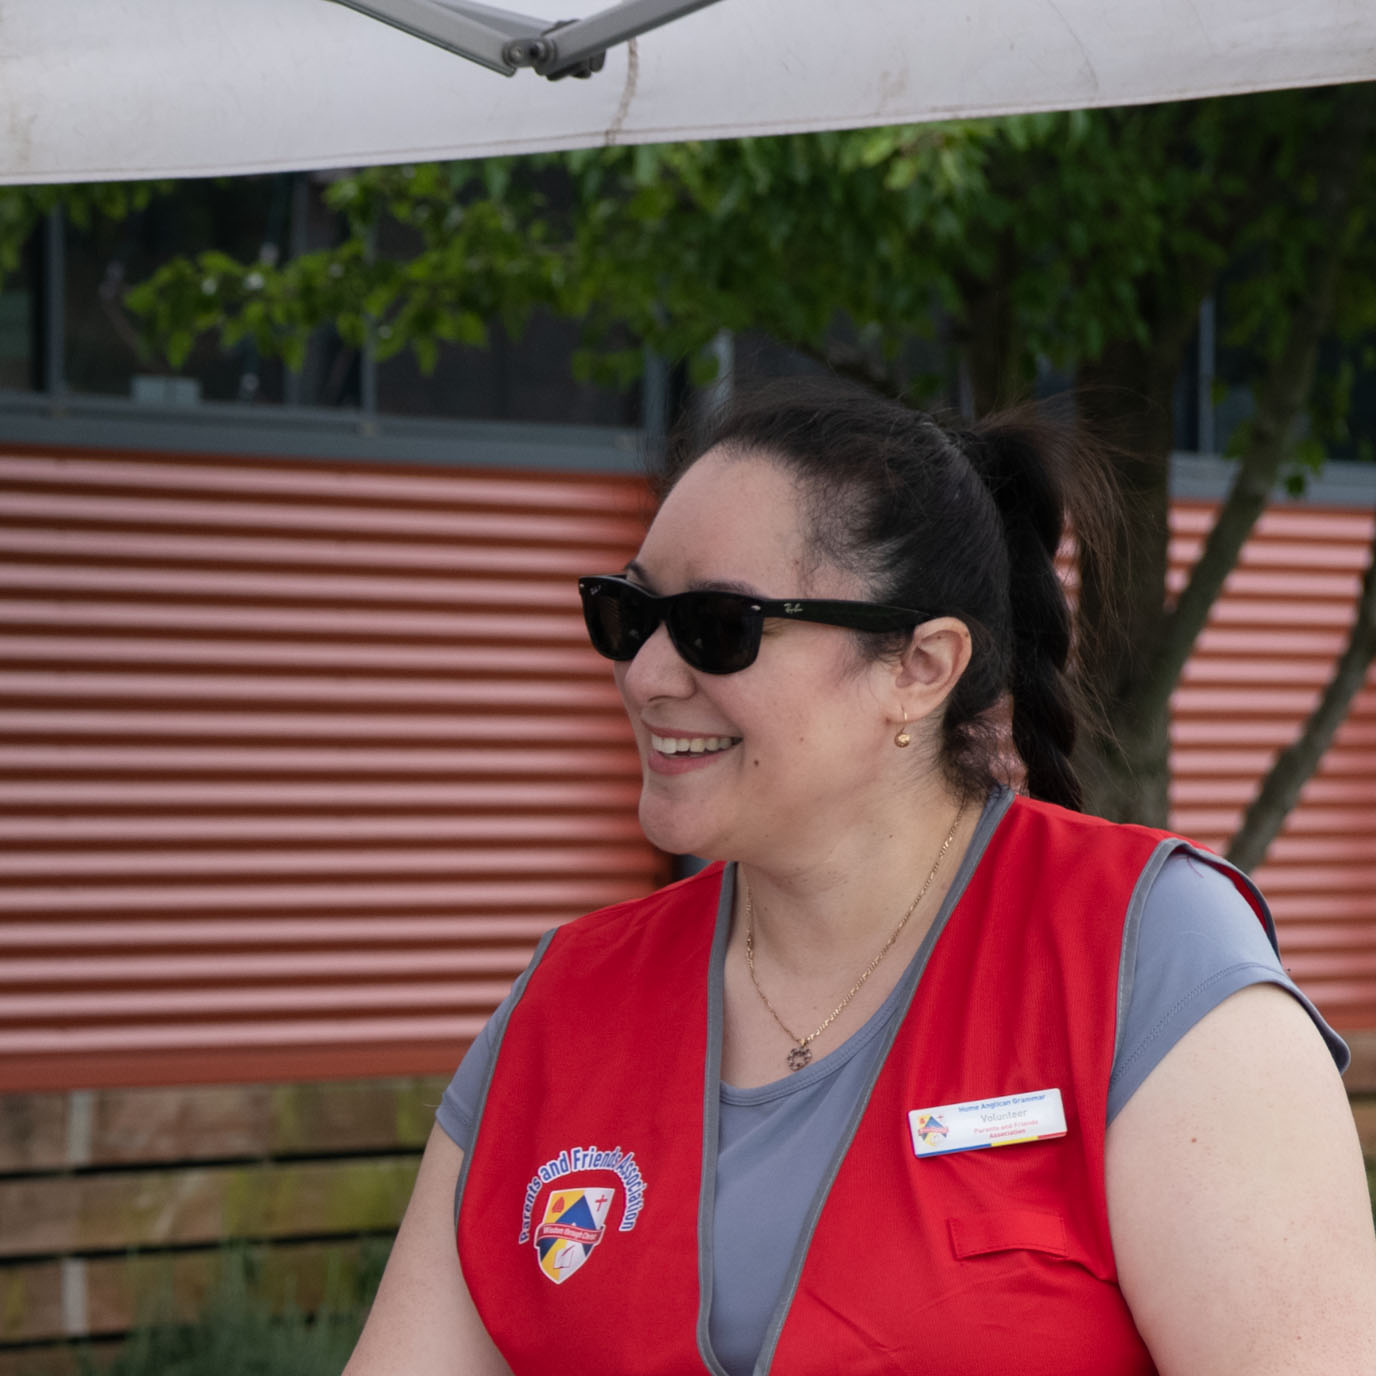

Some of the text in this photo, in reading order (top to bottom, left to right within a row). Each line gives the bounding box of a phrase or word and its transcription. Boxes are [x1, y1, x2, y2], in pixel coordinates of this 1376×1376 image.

[980, 1100, 1011, 1111] Anglican
[1012, 1094, 1046, 1104] Grammar
[980, 1109, 1027, 1123] Volunteer
[519, 1146, 647, 1244] Parents and Friends Association
